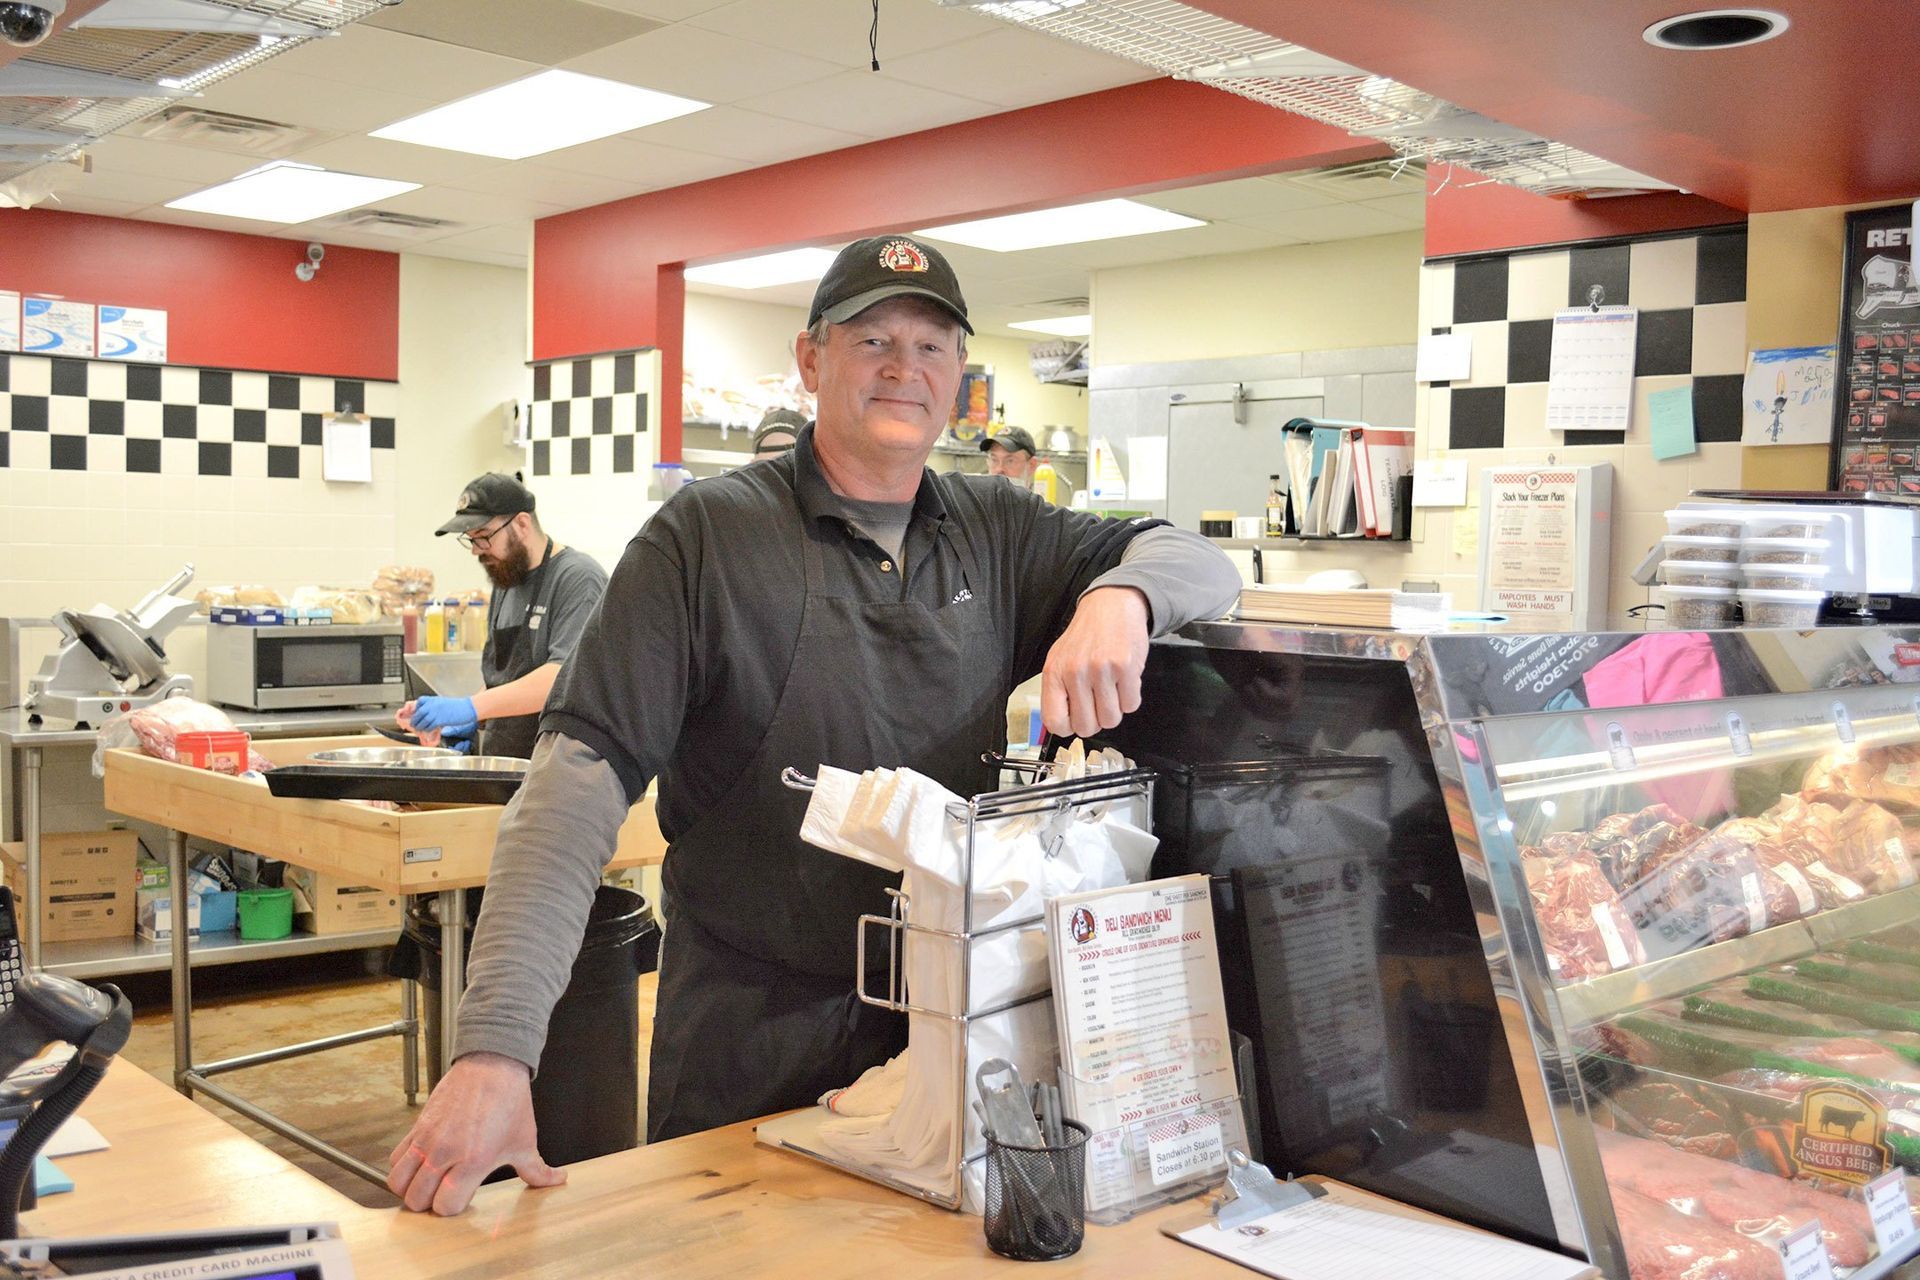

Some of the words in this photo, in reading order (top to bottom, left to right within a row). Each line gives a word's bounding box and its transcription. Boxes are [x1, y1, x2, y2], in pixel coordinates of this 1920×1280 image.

[1499, 592, 1537, 601] EMPLOYEES
[1544, 593, 1564, 603] MUST
[1530, 602, 1556, 611] HANDS
[1105, 916, 1118, 932] DELI
[1120, 911, 1152, 930] SANDWICH
[1153, 907, 1172, 924] MENU
[1156, 1144, 1192, 1163] Sandwich
[1193, 1137, 1219, 1151] Station
[1796, 1147, 1842, 1167] ANGUS
[1846, 1157, 1876, 1173] BEEF
[1802, 1137, 1873, 1158] CERTIFIED
[1157, 1161, 1183, 1176] Closes
[1184, 1158, 1191, 1167] at
[1192, 1152, 1208, 1165] 6:30
[1209, 1149, 1221, 1161] pm
[145, 1266, 197, 1280] CREDIT
[200, 1259, 241, 1274] CARD
[246, 1248, 316, 1267] MACHINE
